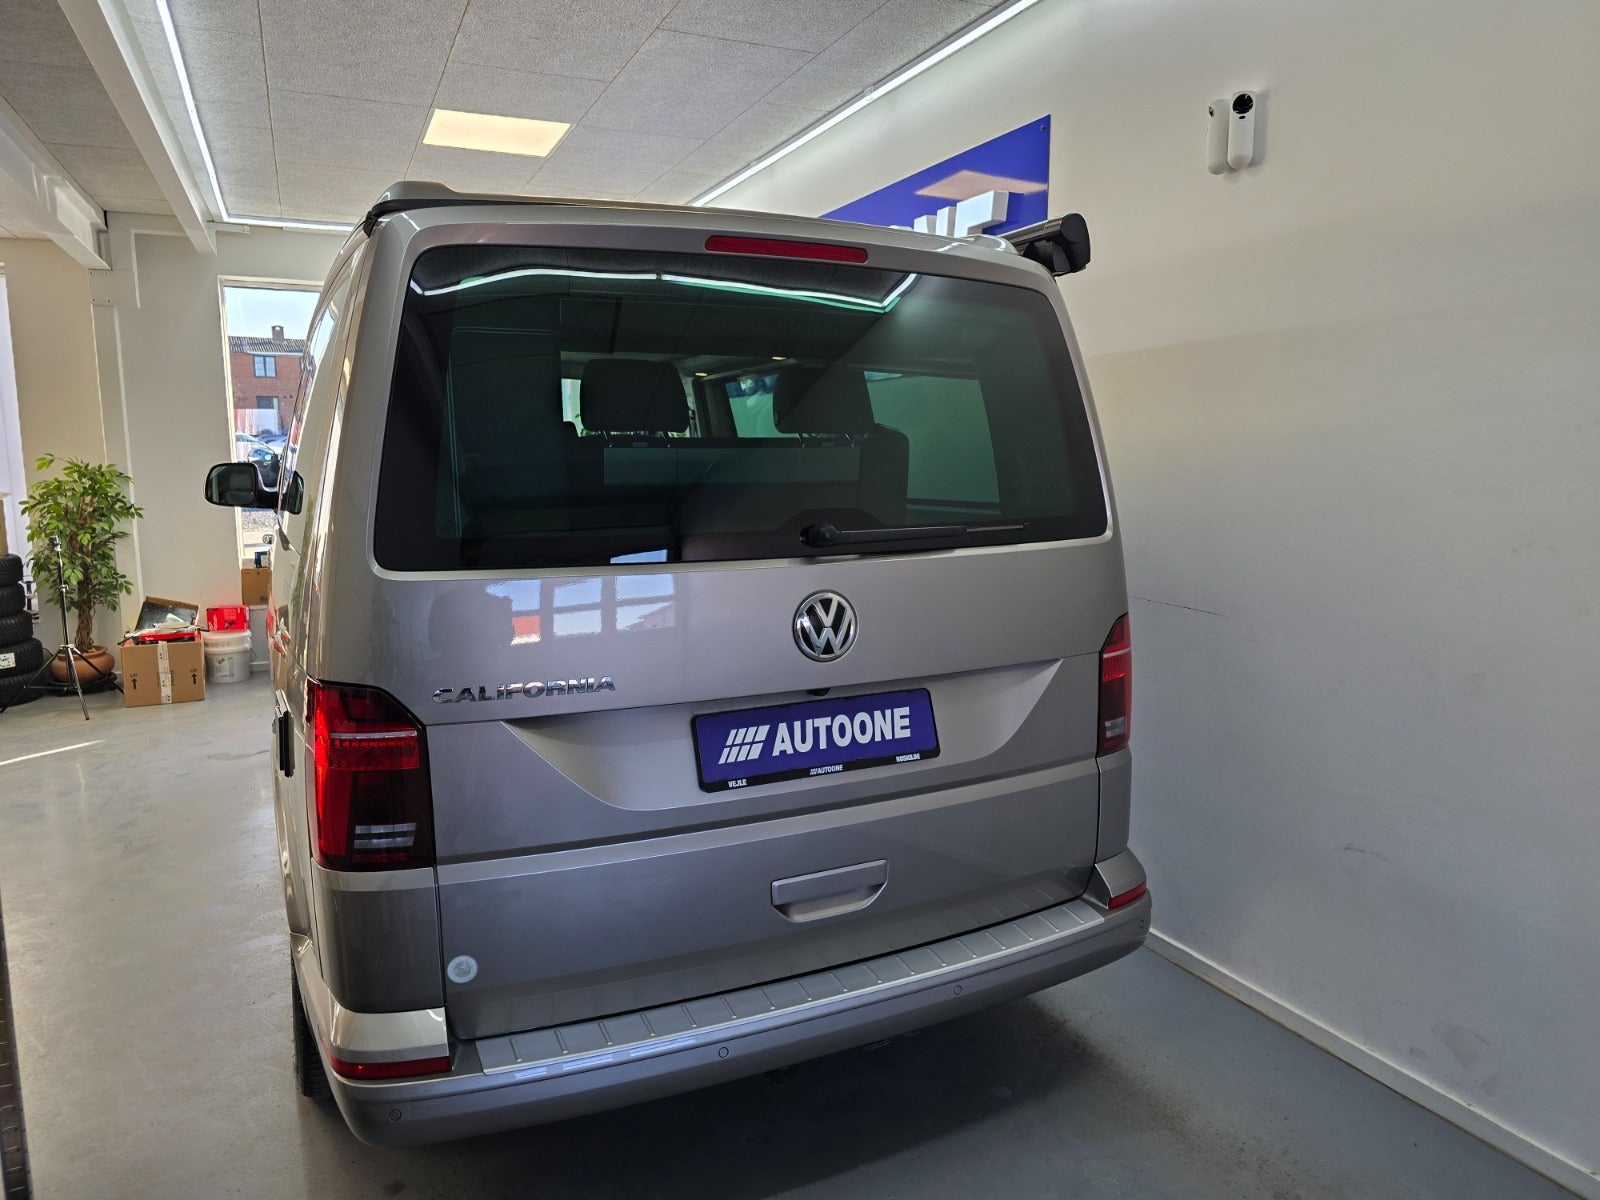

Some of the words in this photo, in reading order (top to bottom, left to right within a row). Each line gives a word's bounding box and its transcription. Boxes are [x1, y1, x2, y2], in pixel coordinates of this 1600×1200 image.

[795, 592, 856, 659] VW
[432, 675, 616, 704] CALIFORNIA
[772, 706, 911, 757] AUTOONE
[728, 778, 747, 788] VEJLE
[817, 764, 844, 775] AUTOONE
